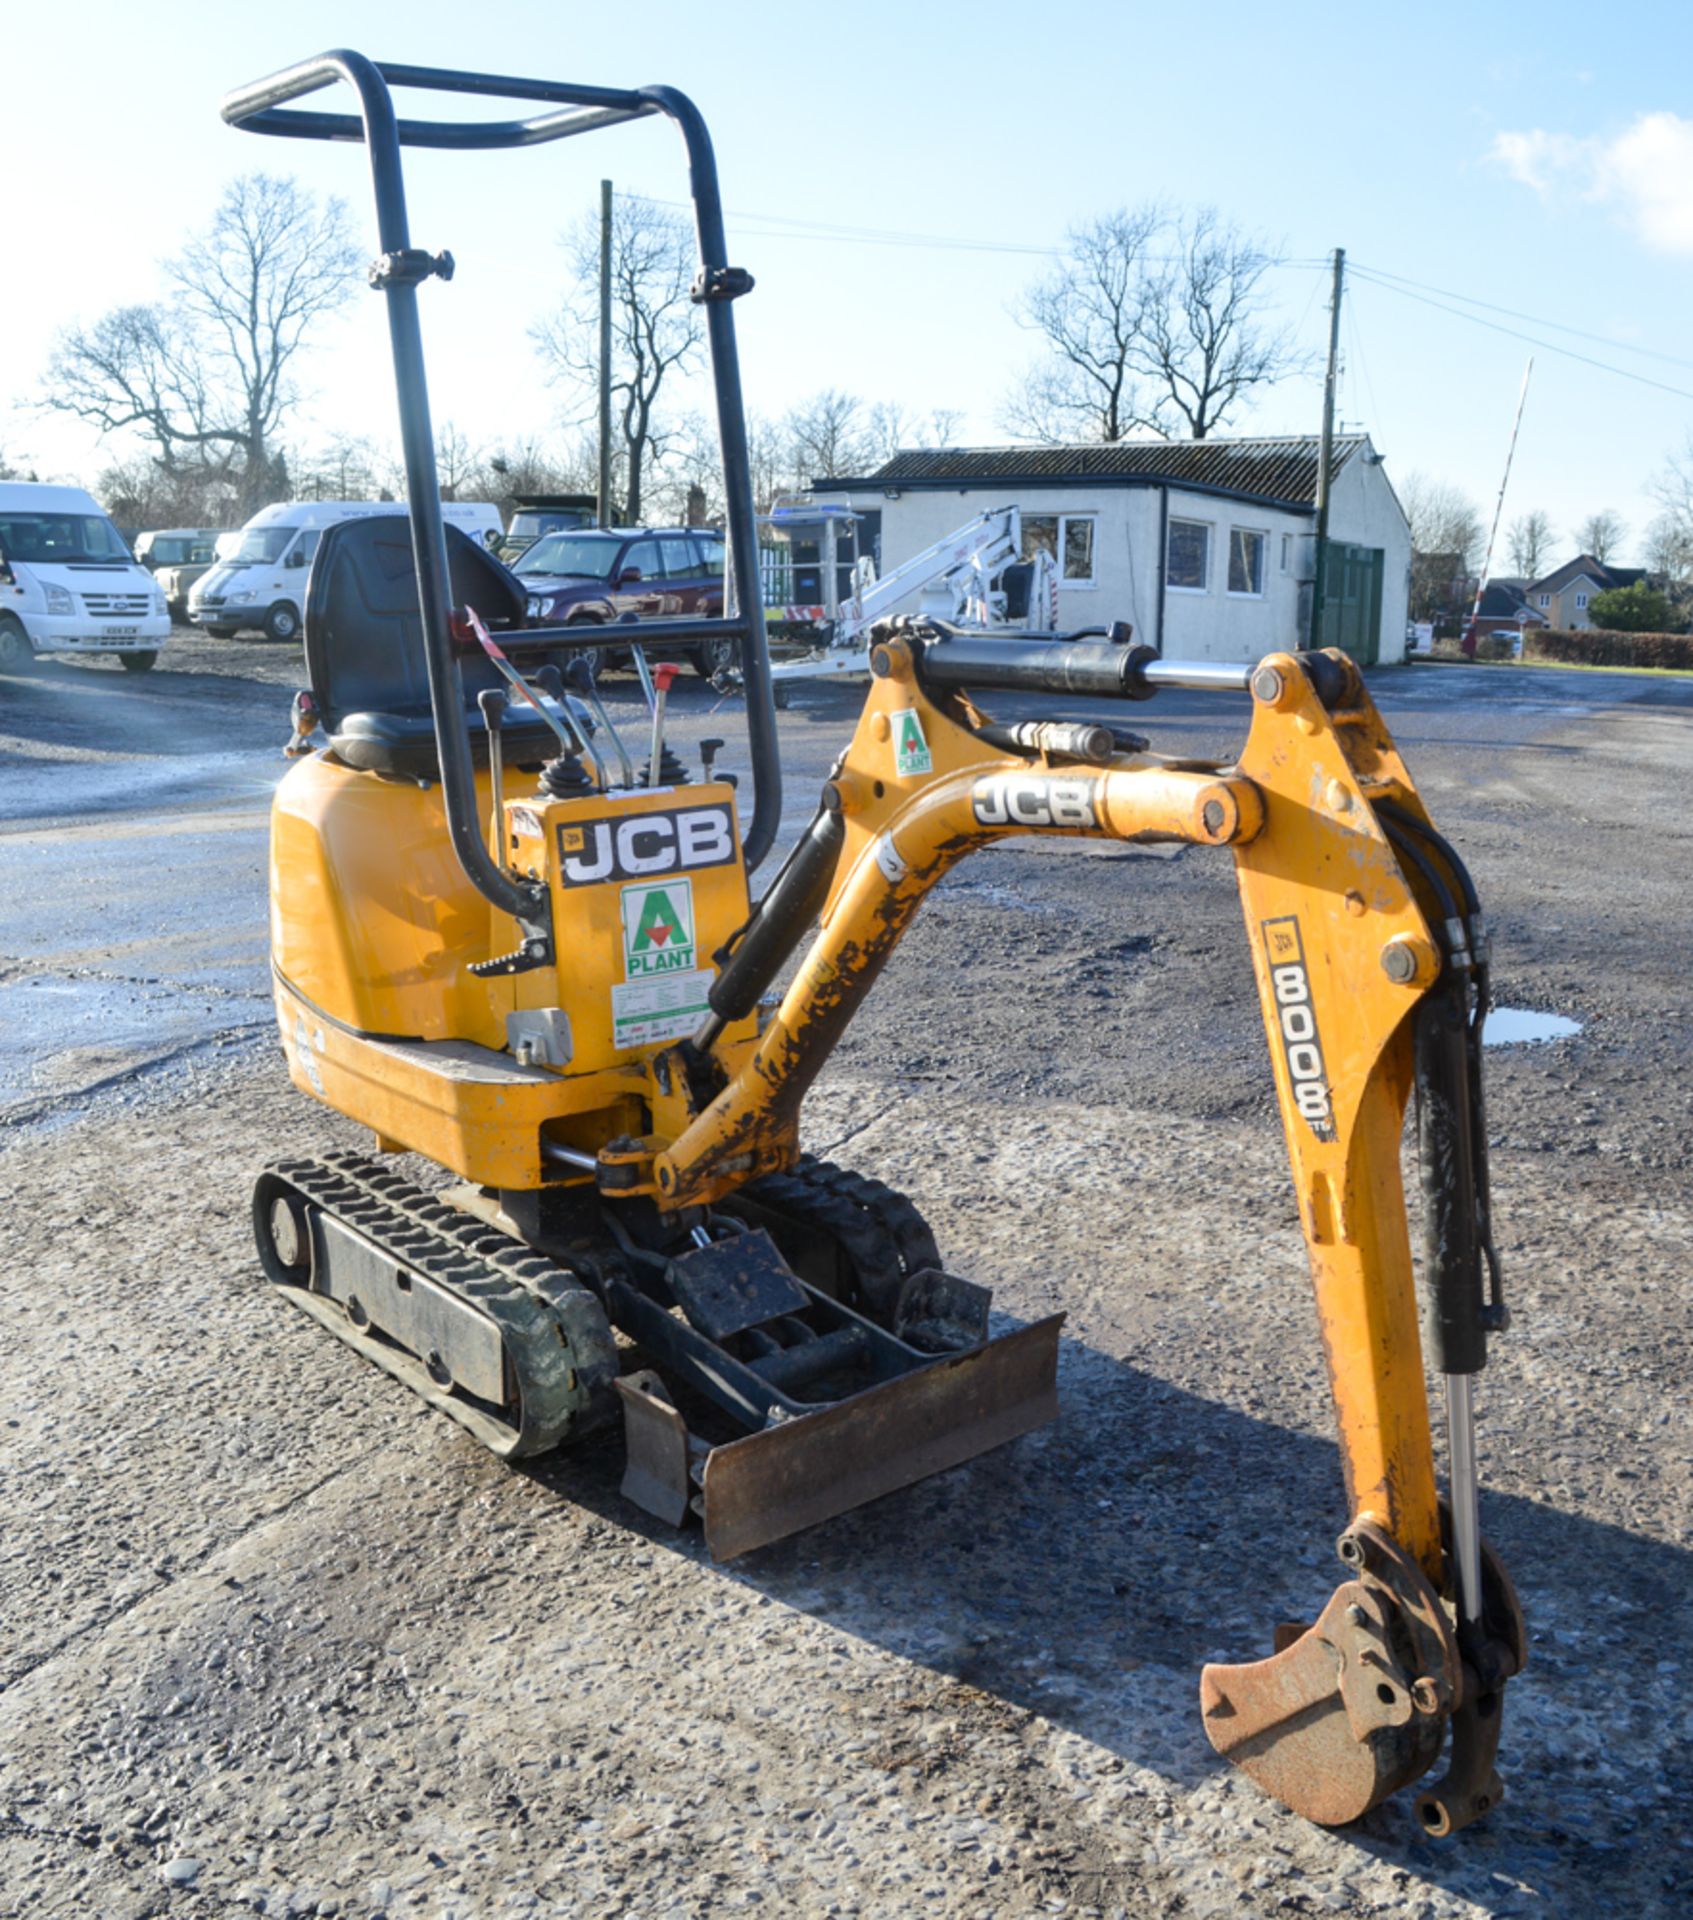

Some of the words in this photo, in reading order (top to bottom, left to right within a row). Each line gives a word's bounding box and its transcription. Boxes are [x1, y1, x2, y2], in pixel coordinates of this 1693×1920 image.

[900, 715, 927, 755] A
[898, 755, 930, 770] PLANT
[973, 776, 1096, 828] JCB
[564, 808, 733, 882] JCB
[631, 889, 689, 952] A
[627, 948, 694, 975] PLANT
[1273, 964, 1330, 1120] 8008
